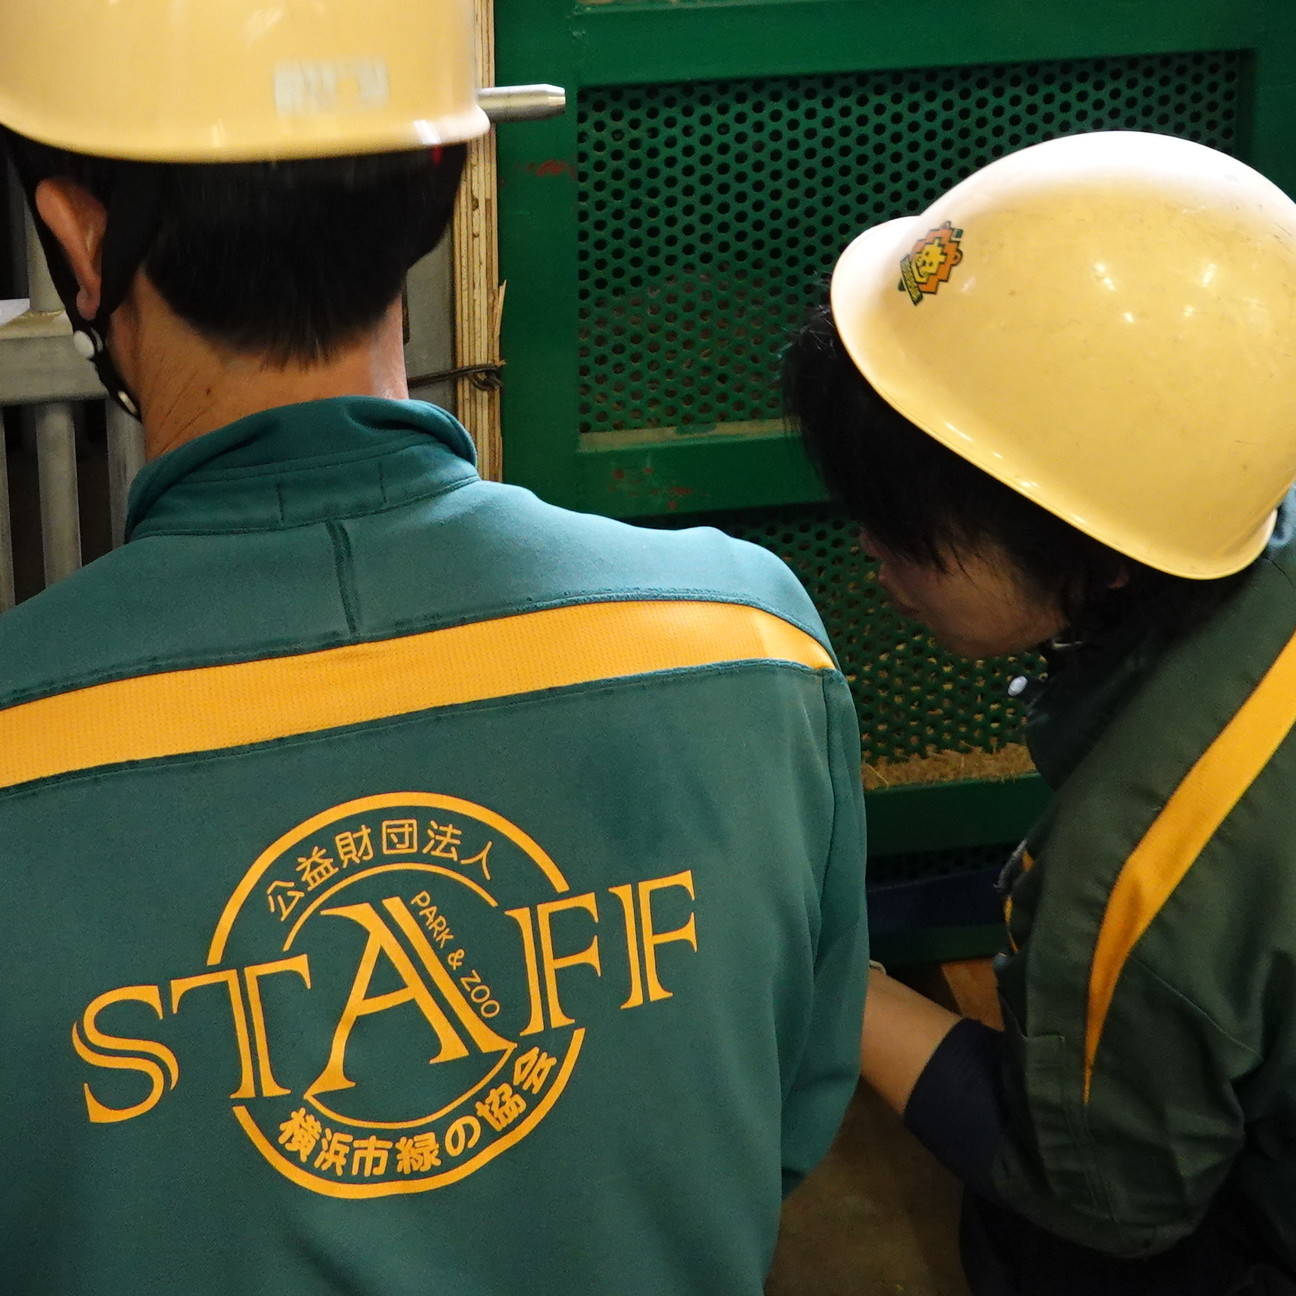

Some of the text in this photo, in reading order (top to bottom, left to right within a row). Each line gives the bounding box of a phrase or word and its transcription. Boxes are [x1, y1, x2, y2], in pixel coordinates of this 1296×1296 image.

[266, 819, 498, 921] 公益財団法人
[71, 870, 697, 1124] STAFF
[410, 889, 501, 1019] PARK & ZOO
[277, 1046, 559, 1177] 横浜市緑の協会
